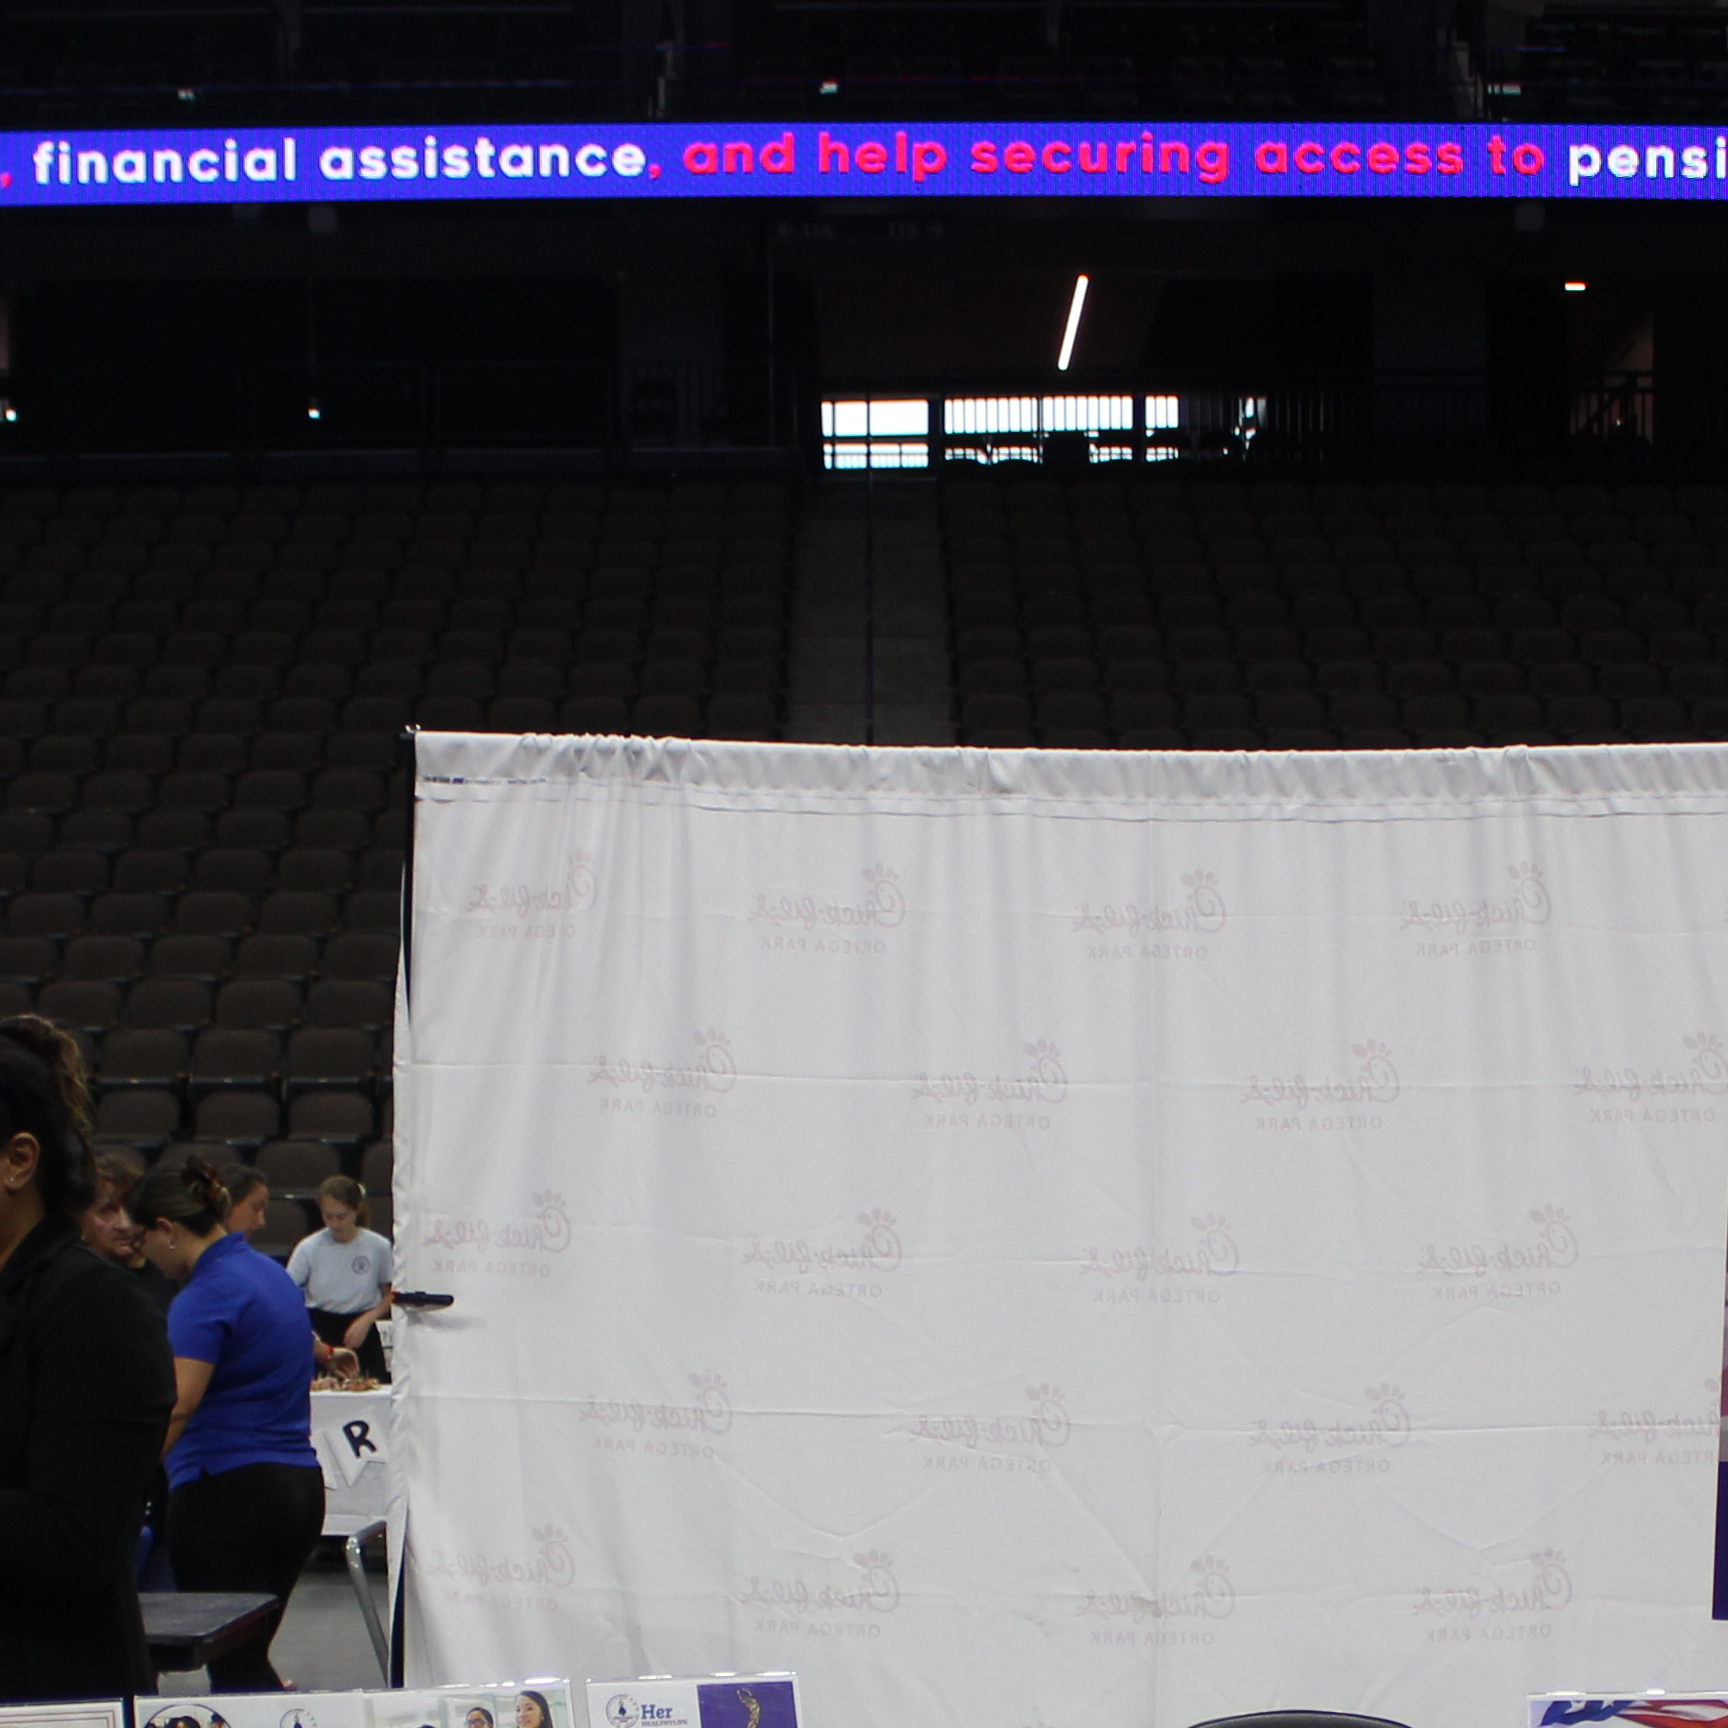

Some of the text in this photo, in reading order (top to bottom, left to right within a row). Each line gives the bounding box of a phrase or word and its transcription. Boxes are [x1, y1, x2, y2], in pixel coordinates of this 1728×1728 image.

[33, 138, 296, 187] financial
[319, 136, 661, 180] assistance,
[683, 131, 794, 174] and
[819, 131, 946, 182] help
[971, 131, 1229, 184] securing
[1255, 140, 1463, 175] access
[1488, 135, 1545, 176] to
[641, 1704, 673, 1719] Her
